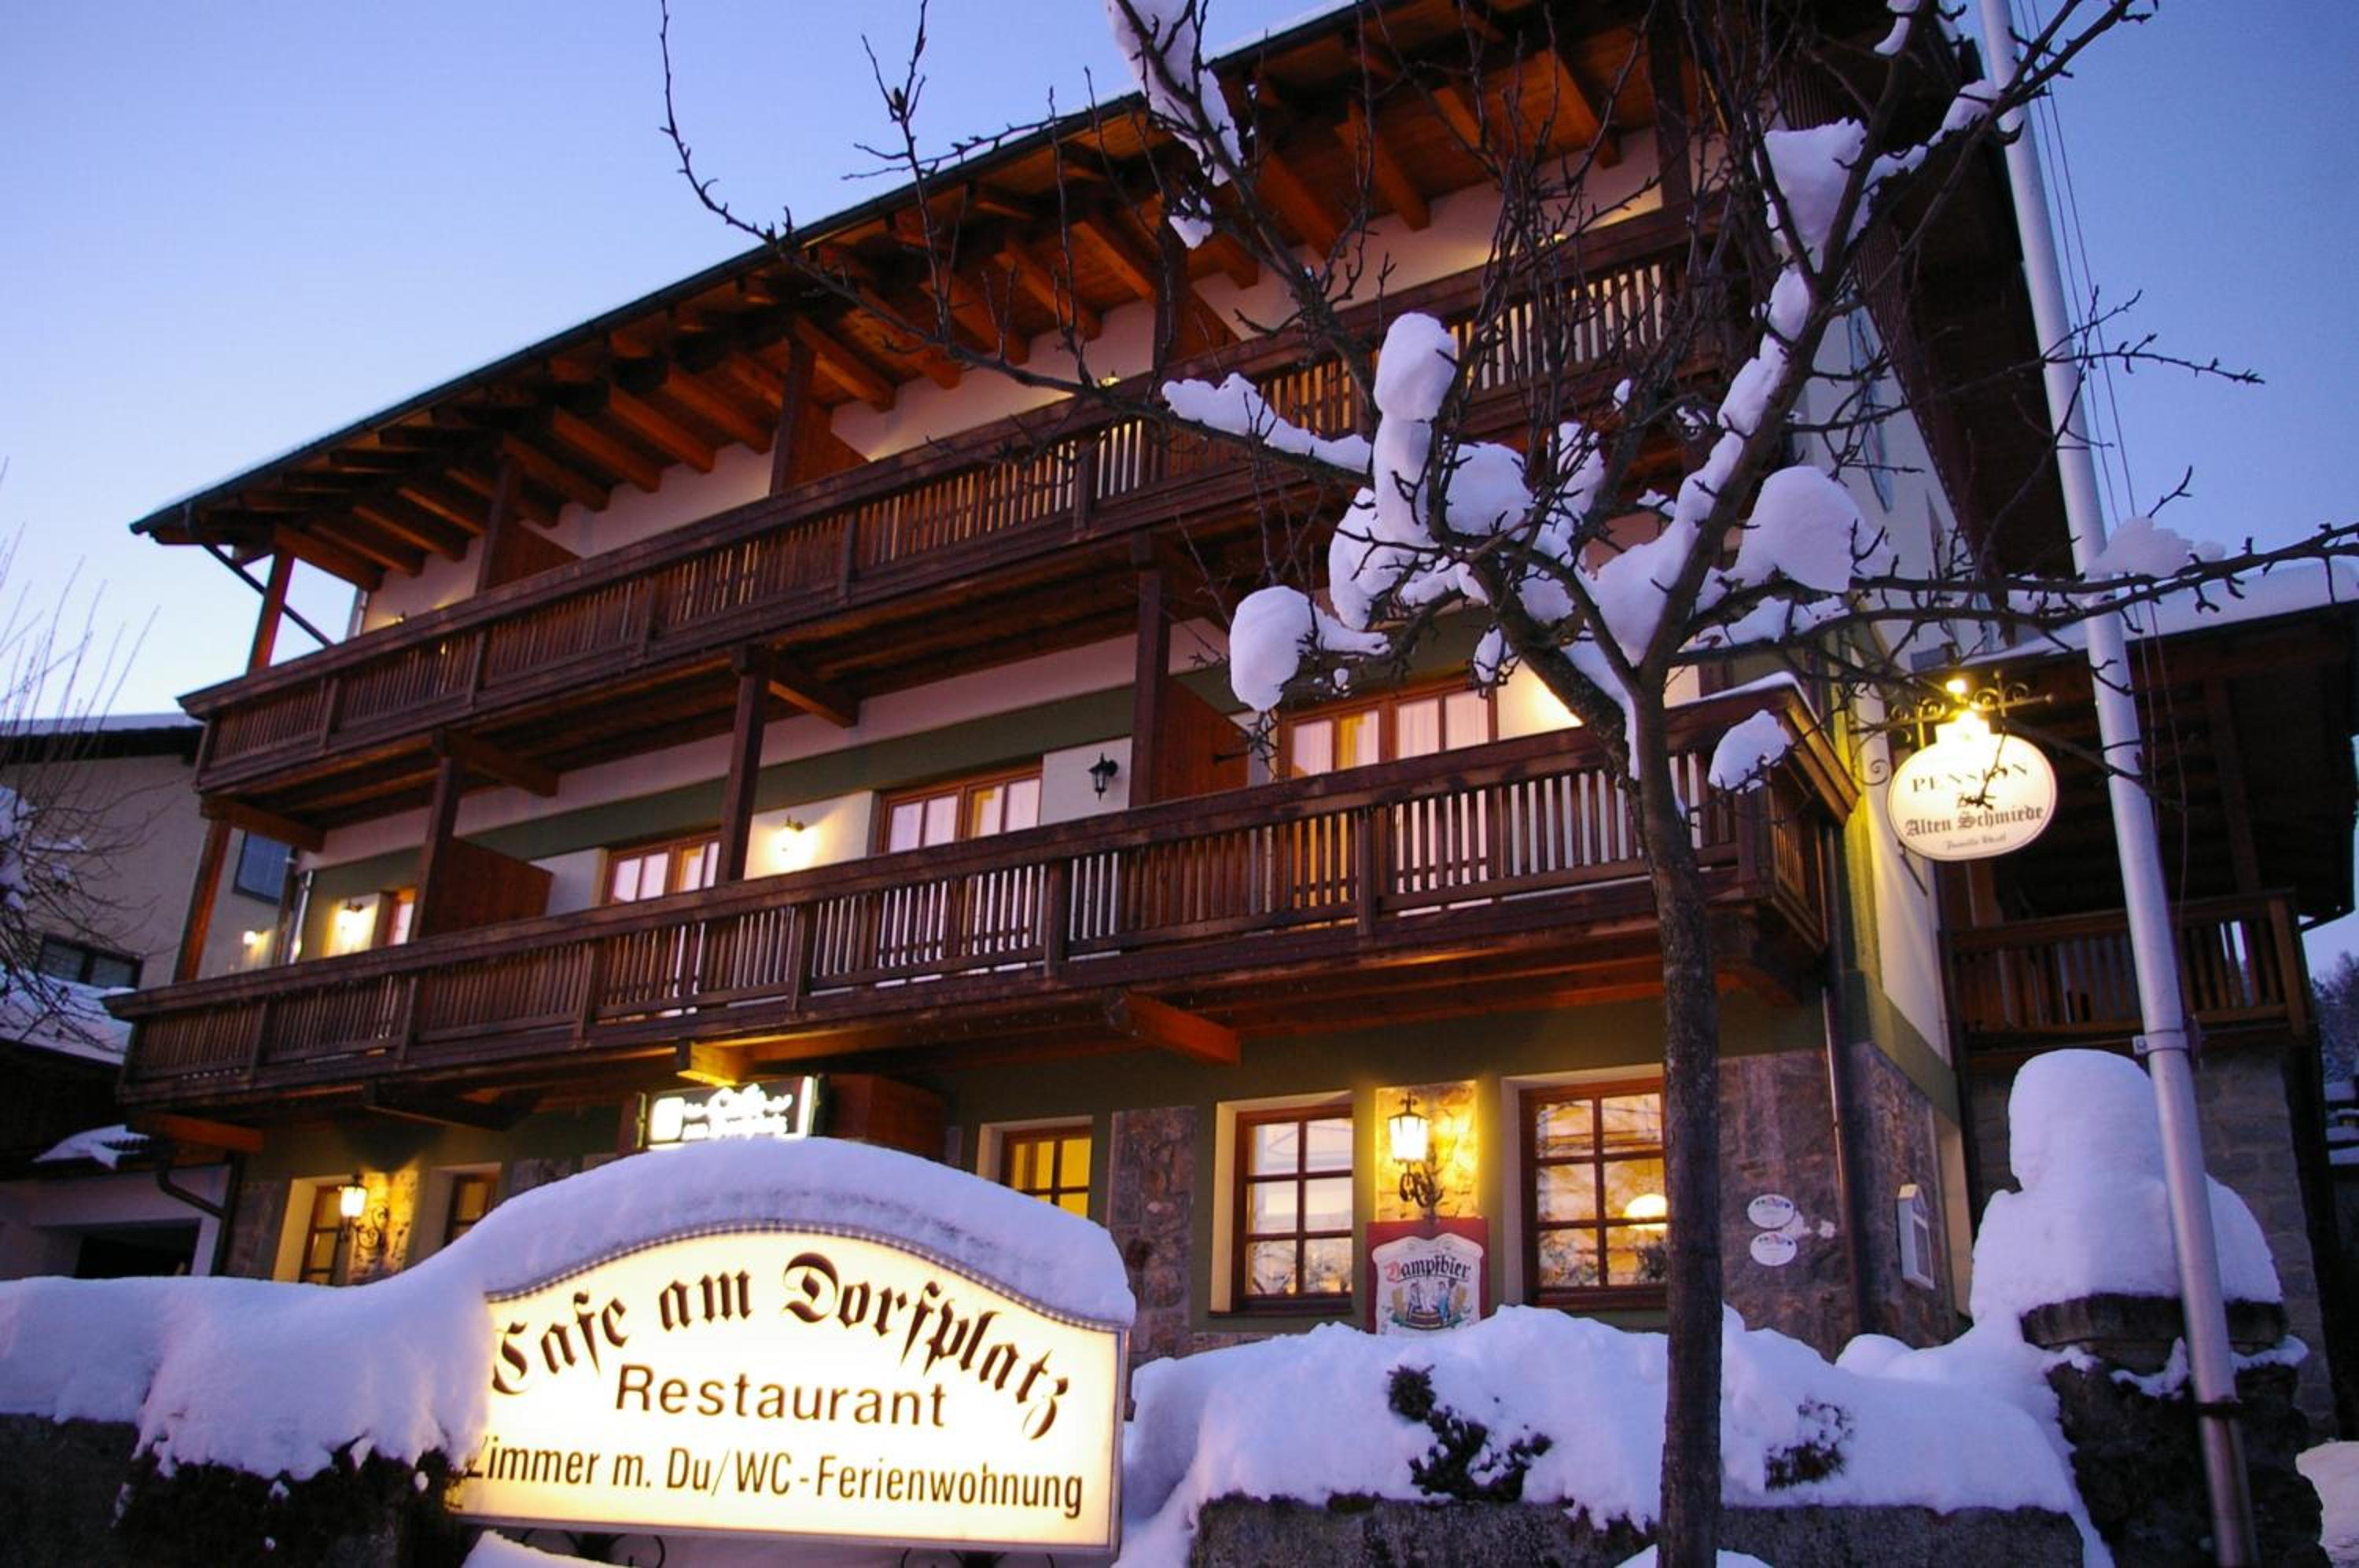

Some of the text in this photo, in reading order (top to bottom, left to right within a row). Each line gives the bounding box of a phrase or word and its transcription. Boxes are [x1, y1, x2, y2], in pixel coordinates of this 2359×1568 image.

[1904, 805, 2044, 837] Alten Schmiede
[1384, 1254, 1471, 1284] Dampfbier
[491, 1252, 1070, 1440] Cafe am Dorfplatz
[615, 1364, 947, 1427] Restaurant
[613, 1452, 652, 1489] m.
